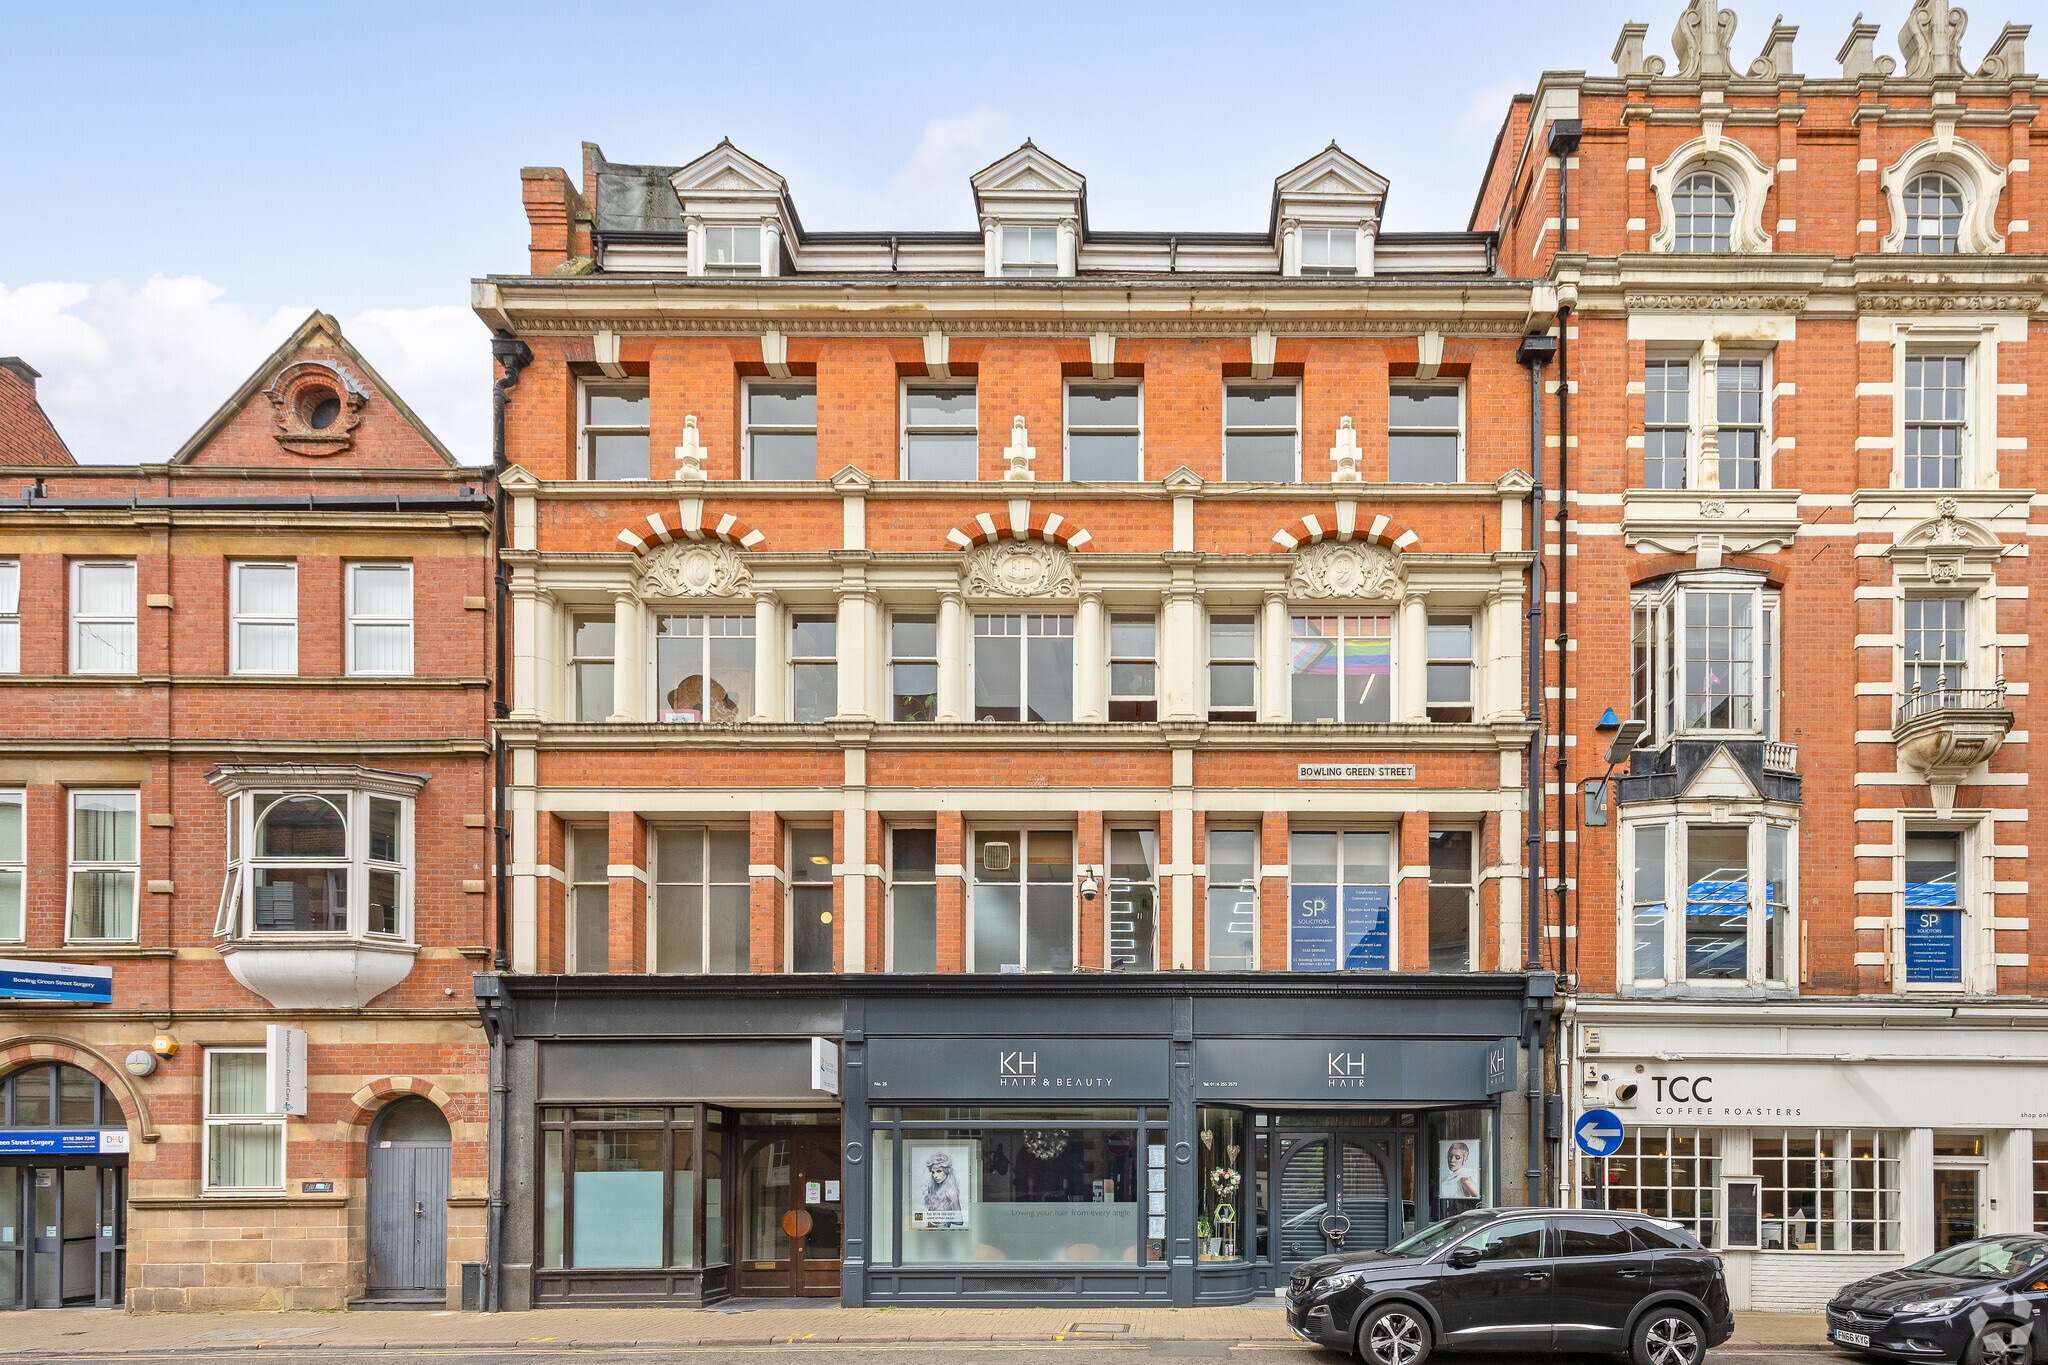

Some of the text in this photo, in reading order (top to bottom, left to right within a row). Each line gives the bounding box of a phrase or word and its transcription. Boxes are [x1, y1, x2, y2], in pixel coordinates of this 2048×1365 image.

[1300, 767, 1413, 776] BOWLING GREEN STREET
[1302, 899, 1326, 917] SP
[1920, 914, 1939, 928] SP
[13, 977, 37, 985] Bowling
[72, 980, 95, 989] Surgery
[1000, 1051, 1037, 1074] KH
[1328, 1052, 1365, 1075] KH
[1490, 1047, 1505, 1074] KH
[1000, 1078, 1113, 1087] HAIR & BEAUTY
[1328, 1079, 1365, 1088] HAIR
[1651, 1076, 1713, 1103] TCC
[1655, 1107, 1801, 1116] COFFEE ROASTERS
[30, 1139, 55, 1147] Surgery
[106, 1135, 124, 1144] DHU
[1036, 1210, 1052, 1218] your
[1054, 1209, 1068, 1217] hair
[1071, 1209, 1090, 1217] from
[1090, 1210, 1111, 1218] every
[1112, 1209, 1131, 1218] angle
[1837, 1330, 1869, 1345] FN66 KYG
